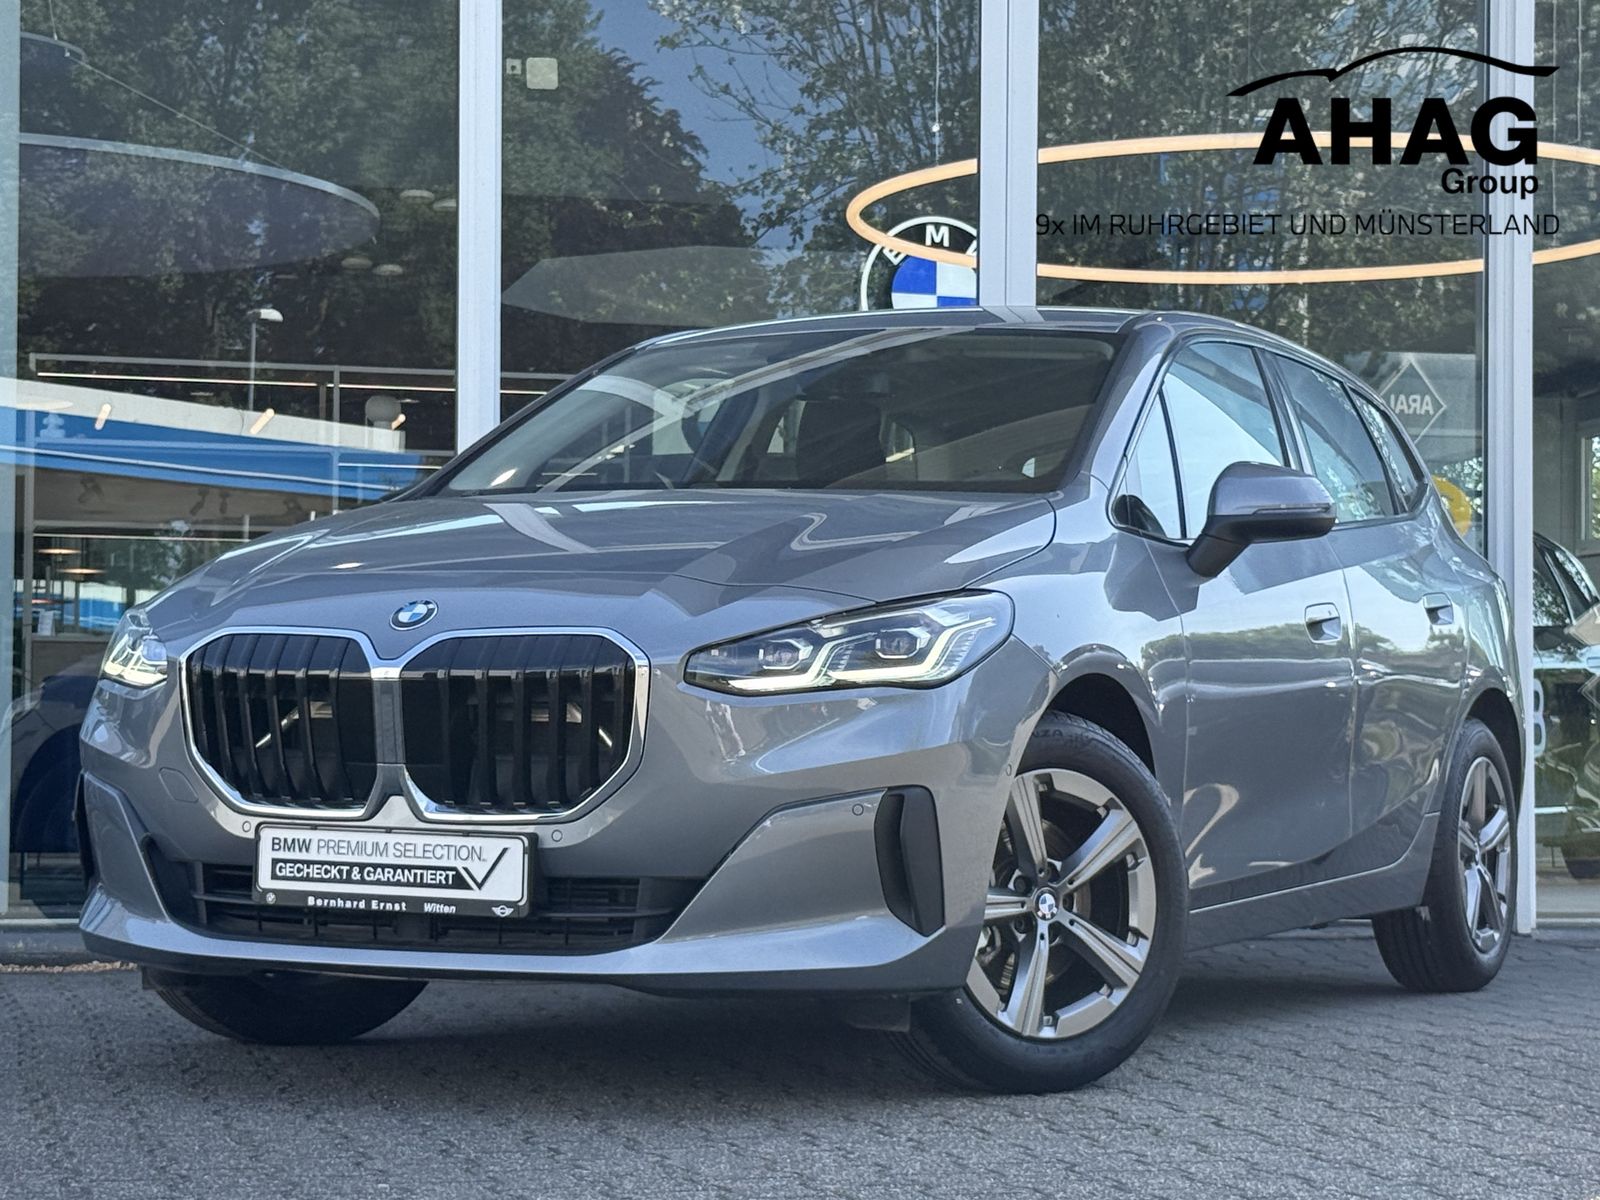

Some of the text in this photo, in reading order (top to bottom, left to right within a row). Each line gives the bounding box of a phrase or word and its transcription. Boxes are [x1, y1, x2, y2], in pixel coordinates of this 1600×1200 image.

[271, 837, 312, 853] BMW
[316, 838, 389, 857] PREMIUM
[275, 862, 456, 885] GECHECKT & GARANTIERT
[307, 895, 457, 914] Bernhard Ernst Witten
